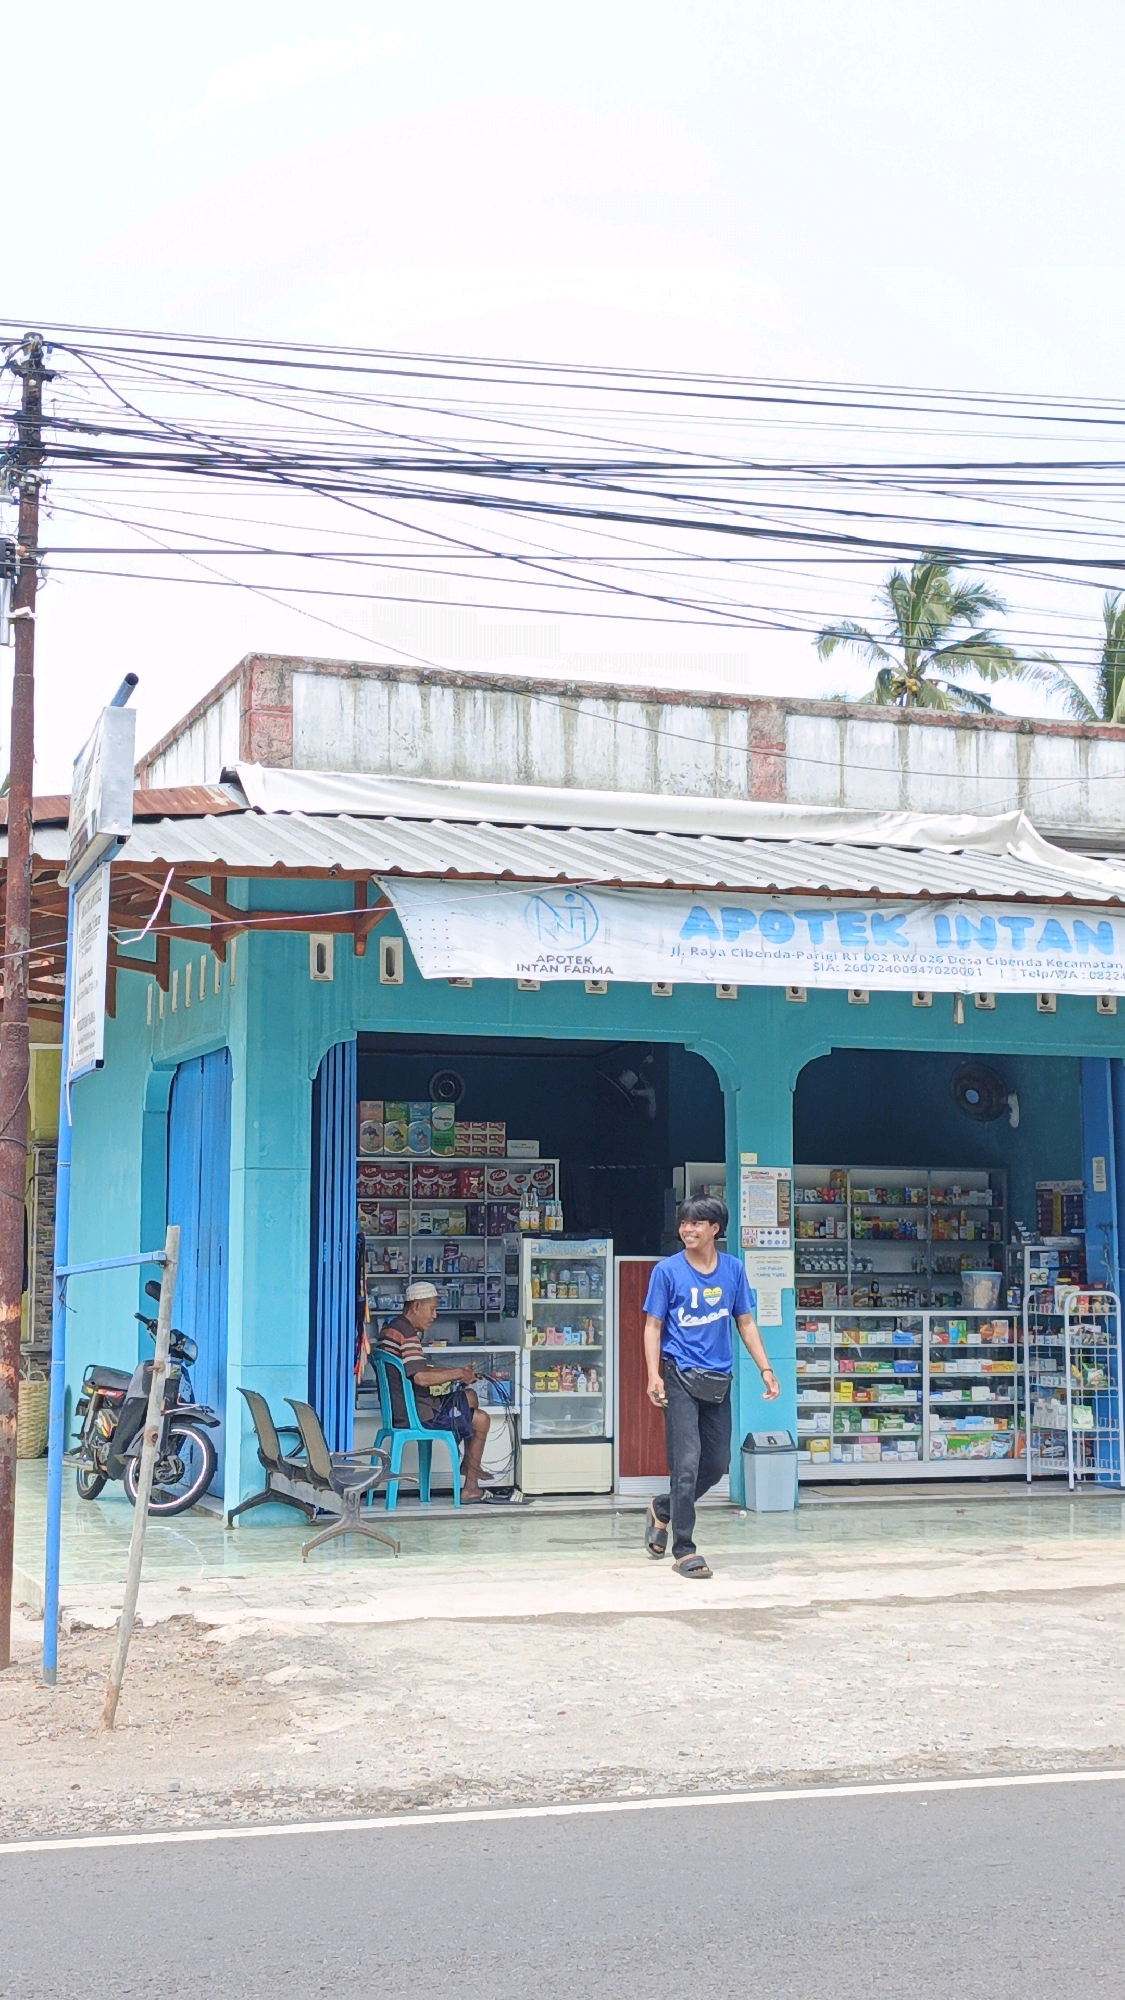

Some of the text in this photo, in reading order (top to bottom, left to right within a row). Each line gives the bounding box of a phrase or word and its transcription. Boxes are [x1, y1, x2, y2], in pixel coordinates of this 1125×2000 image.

[679, 905, 1115, 956] APOTEK INTAN
[536, 954, 594, 966] APOTEK
[690, 946, 726, 959] Raya
[731, 948, 837, 962] Cibenda-Parigi
[842, 952, 859, 961] RT
[864, 952, 888, 962] 002
[892, 953, 916, 963] RW
[919, 954, 944, 964] 026
[947, 955, 982, 965] Desa
[986, 956, 1042, 967] Cibenda
[1046, 958, 1123, 969] Kecamatan
[516, 963, 614, 975] INTAN FARMA
[813, 962, 840, 972] SIA:
[1020, 968, 1078, 980] Telp/WA
[690, 1287, 699, 1309] I
